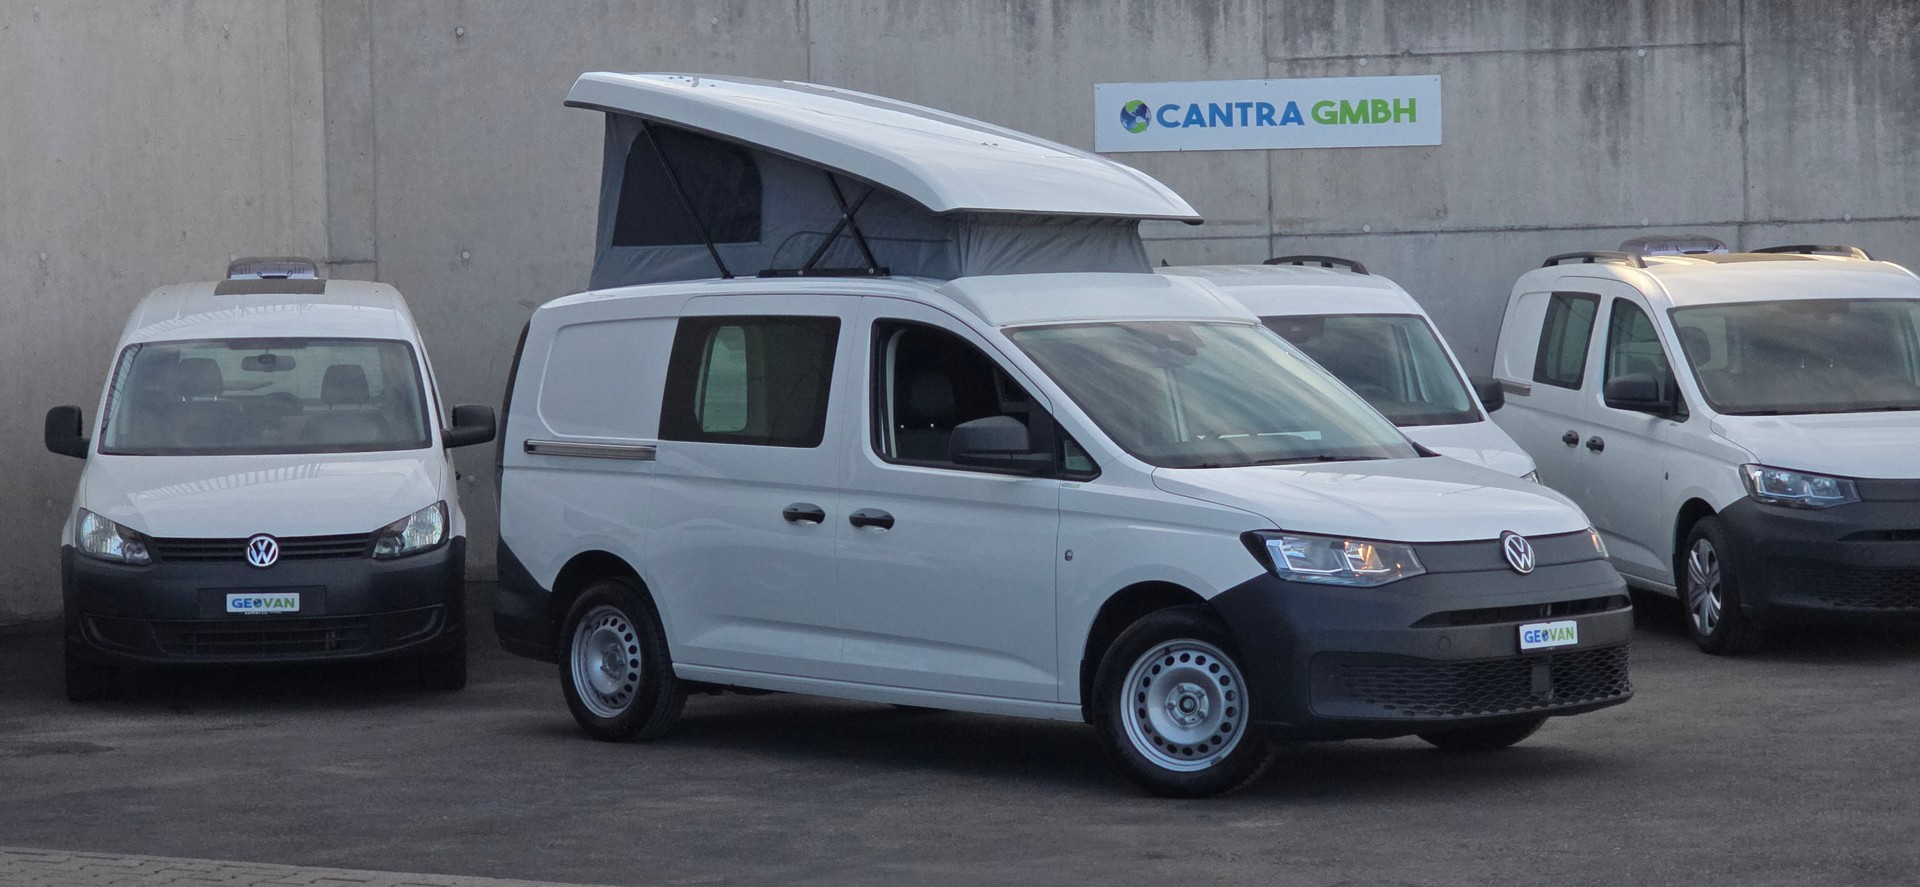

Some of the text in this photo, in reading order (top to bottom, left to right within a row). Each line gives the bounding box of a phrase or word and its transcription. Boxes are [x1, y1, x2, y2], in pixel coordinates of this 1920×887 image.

[1156, 98, 1417, 128] CANTRA GMBH
[231, 598, 295, 609] GEOVAN
[1524, 626, 1574, 644] GEOVAN
